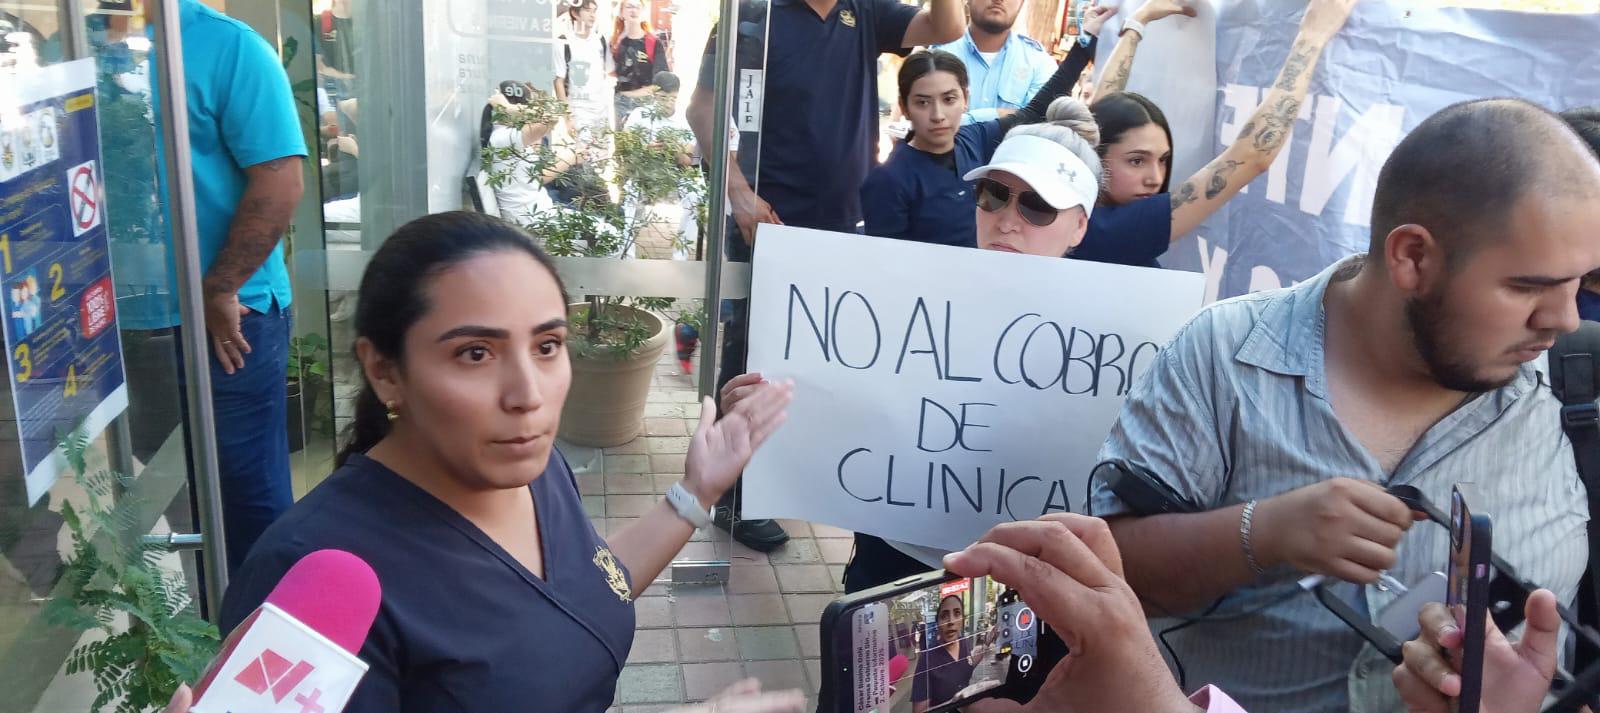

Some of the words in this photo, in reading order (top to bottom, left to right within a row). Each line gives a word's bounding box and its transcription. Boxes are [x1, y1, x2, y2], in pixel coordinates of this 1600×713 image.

[48, 263, 65, 301] 2
[784, 283, 881, 369] NO
[895, 296, 982, 382] AL
[14, 343, 32, 383] 3
[63, 364, 77, 398] 4
[917, 397, 998, 452] DE
[838, 447, 1070, 521] CLINICA
